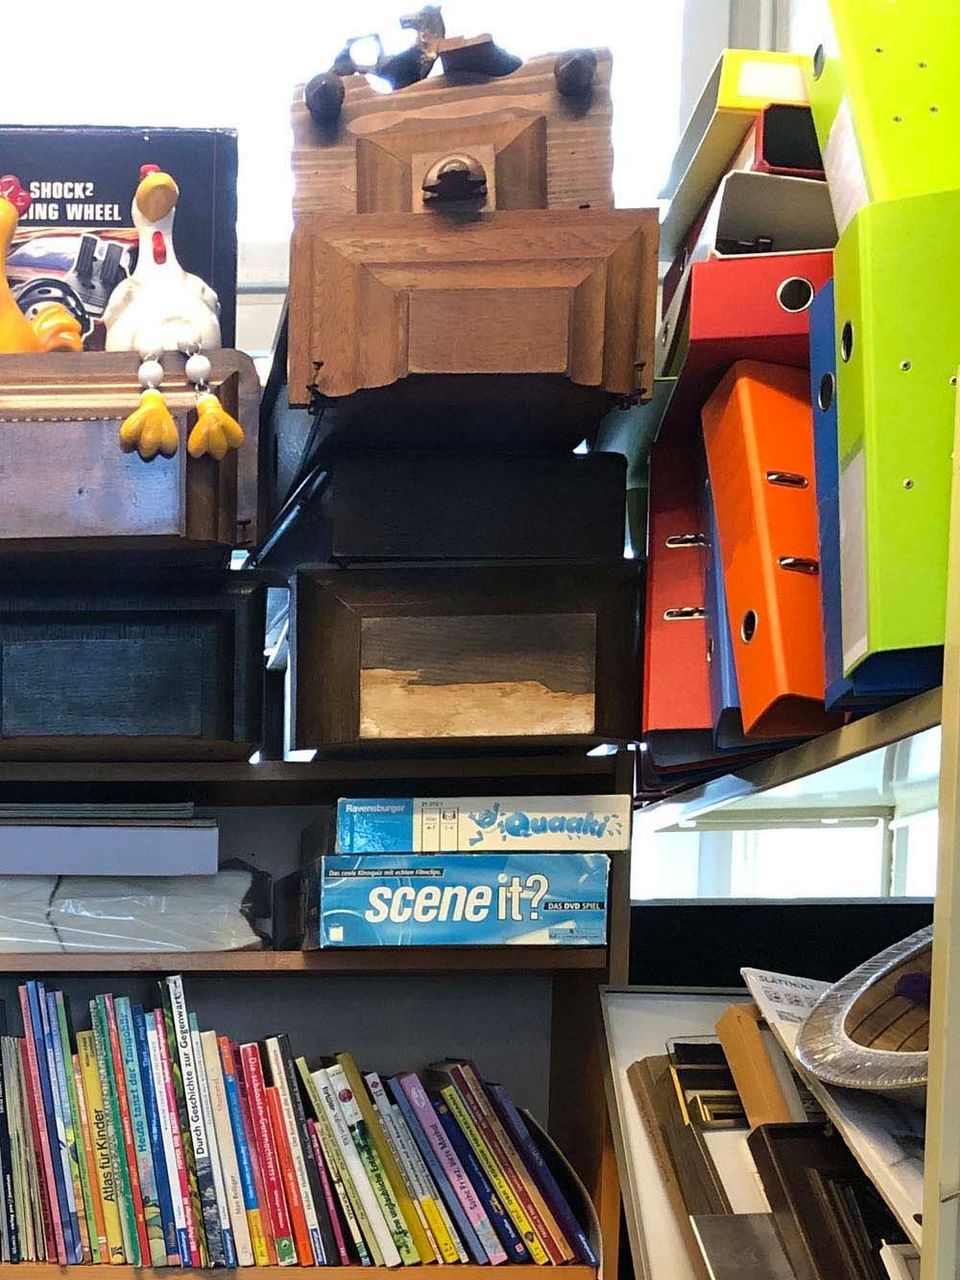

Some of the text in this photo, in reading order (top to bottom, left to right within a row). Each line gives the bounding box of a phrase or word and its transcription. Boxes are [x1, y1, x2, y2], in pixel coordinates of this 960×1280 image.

[67, 203, 122, 221] WHEEL
[346, 804, 406, 814] Ravensburger
[365, 873, 550, 923] scene it?
[564, 902, 581, 910] DVD
[582, 902, 600, 910] SPIEL
[127, 1067, 136, 1082] der
[171, 994, 205, 1154] Durch Geschichte zur Gegenwart
[130, 1088, 141, 1116] tanzt
[447, 1091, 480, 1148] HEINZELMANN
[135, 1121, 146, 1152] Heute
[93, 1108, 113, 1201] Atlas für Kinder
[478, 1147, 503, 1190] FLIEGENDE
[373, 1171, 398, 1219] unglaubliche
[462, 1189, 477, 1209] Suche
[500, 1189, 512, 1205] DER
[389, 1219, 402, 1236] Eine
